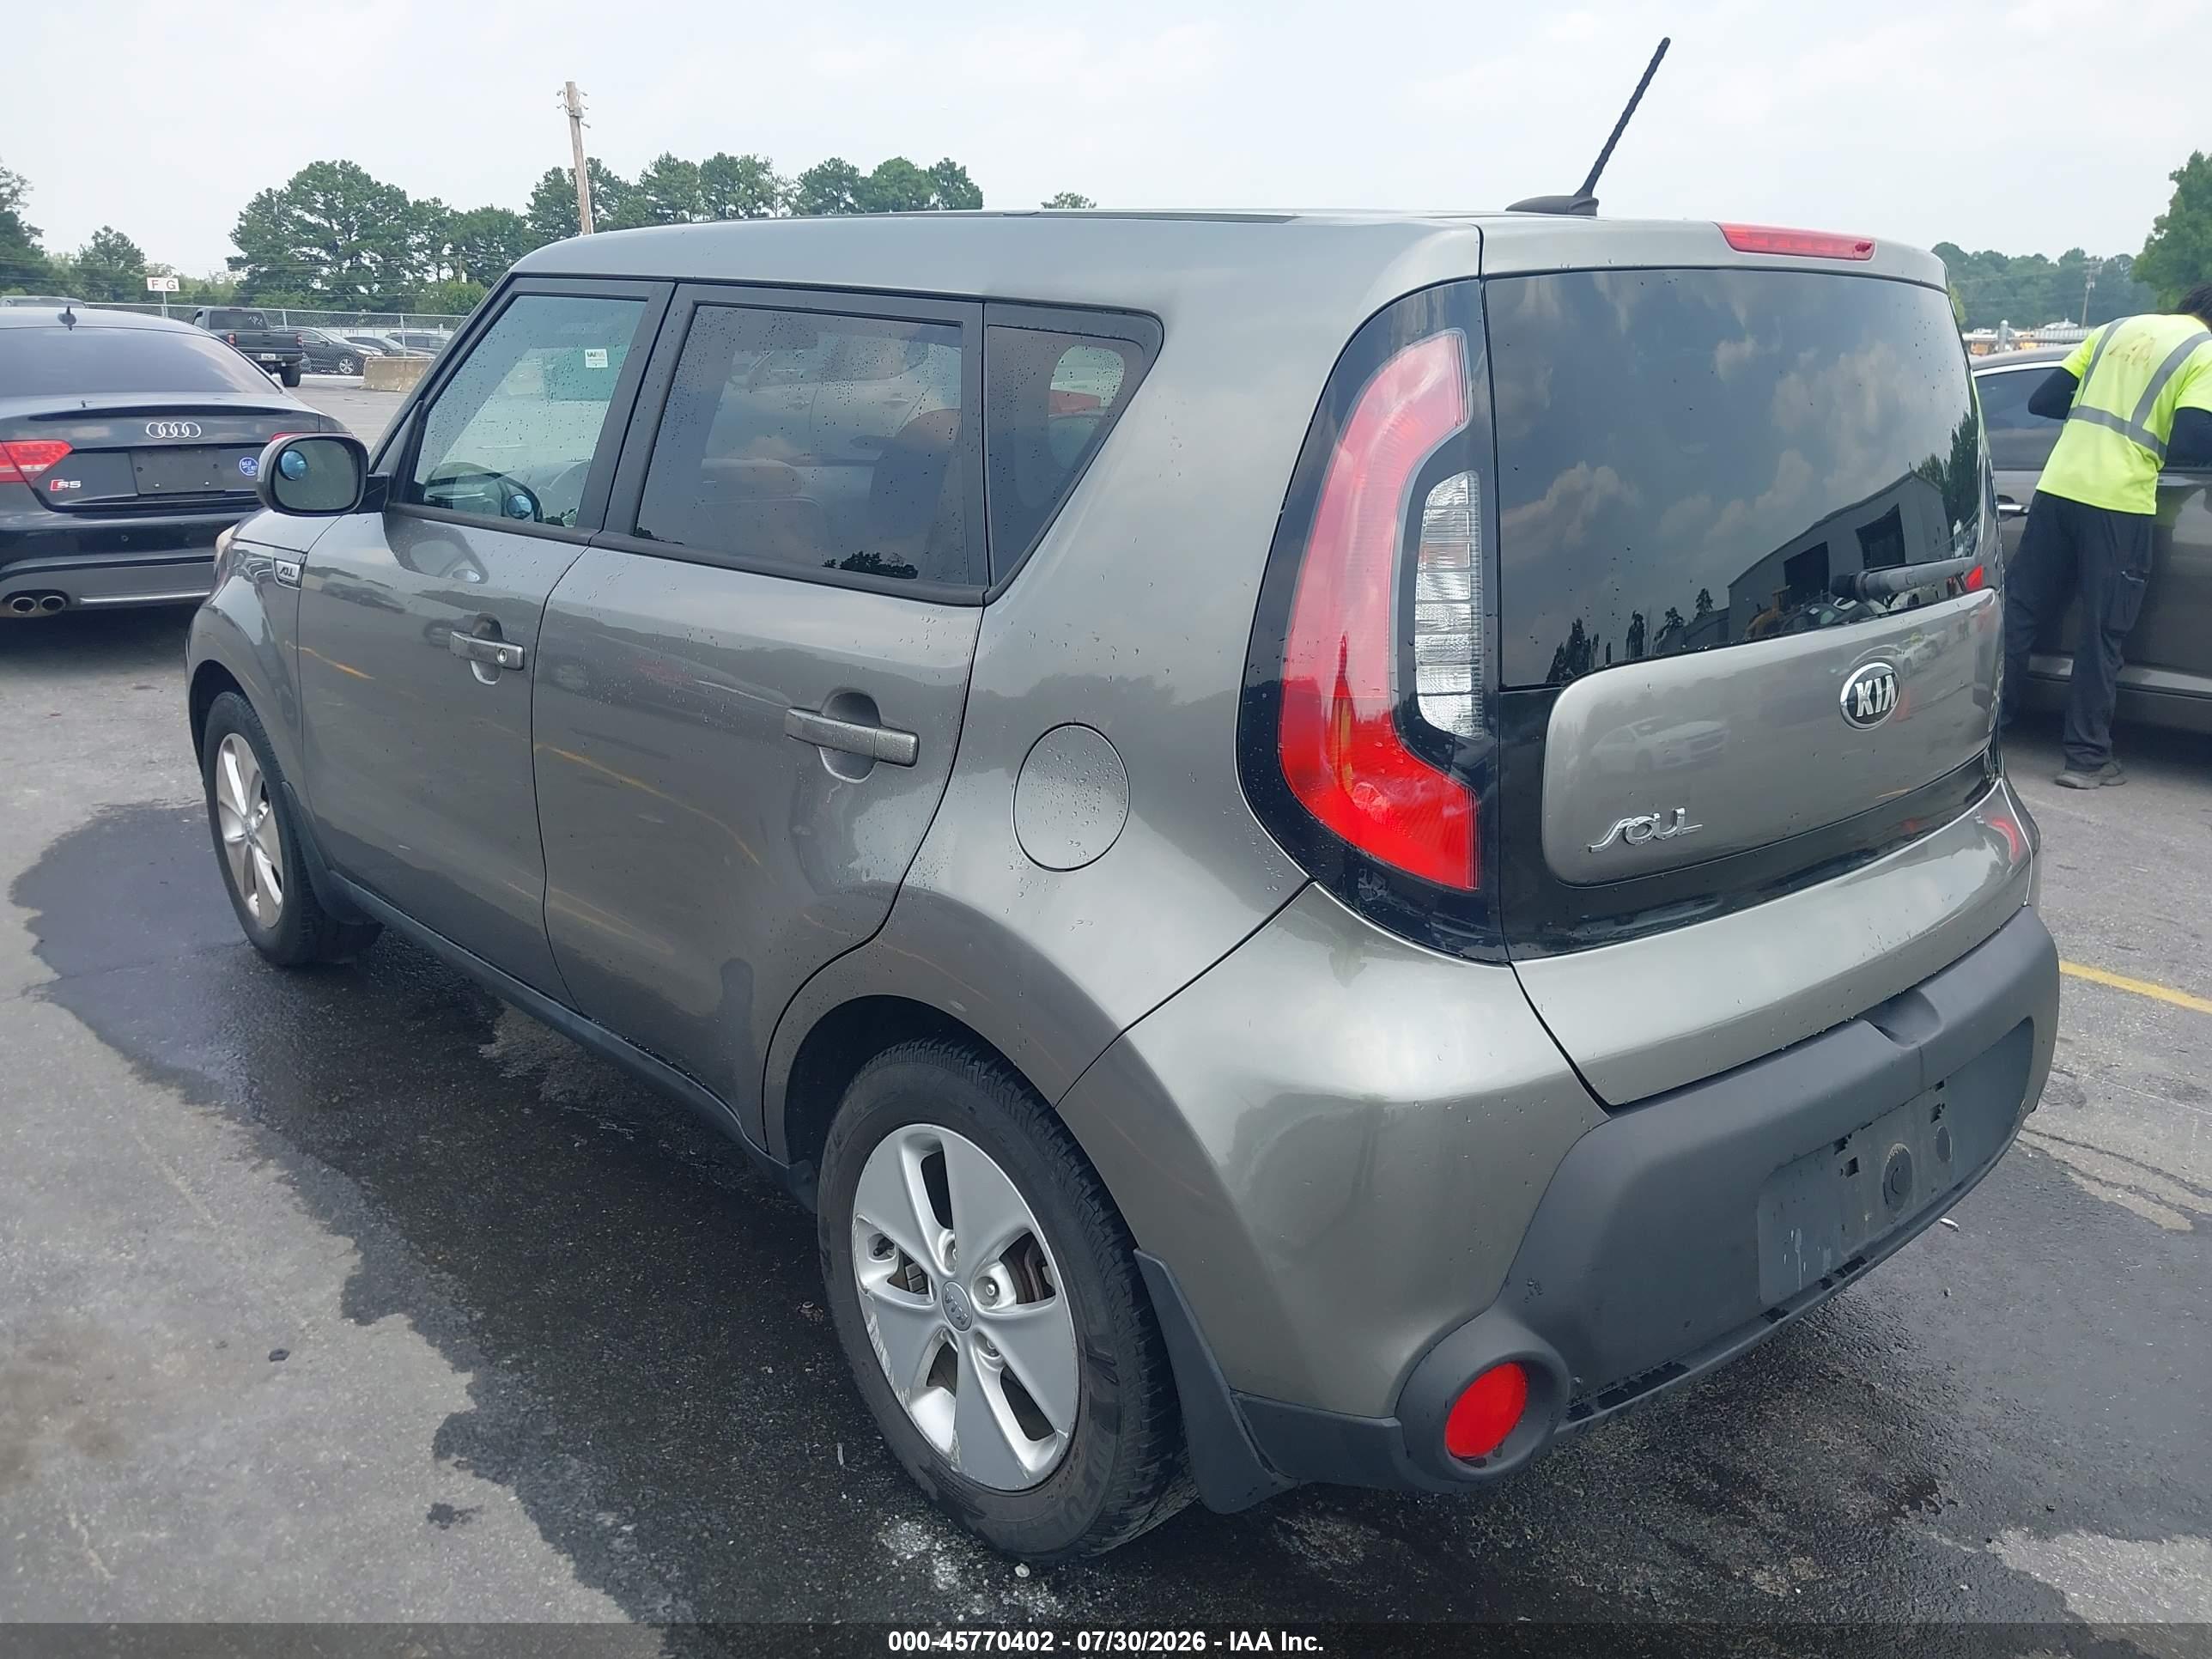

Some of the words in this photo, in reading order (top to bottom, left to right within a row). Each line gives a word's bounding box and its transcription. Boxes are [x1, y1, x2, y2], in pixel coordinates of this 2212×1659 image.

[151, 279, 159, 289] F
[166, 279, 177, 290] G
[1855, 674, 1896, 717] KIA
[1588, 807, 1703, 853] SOUL
